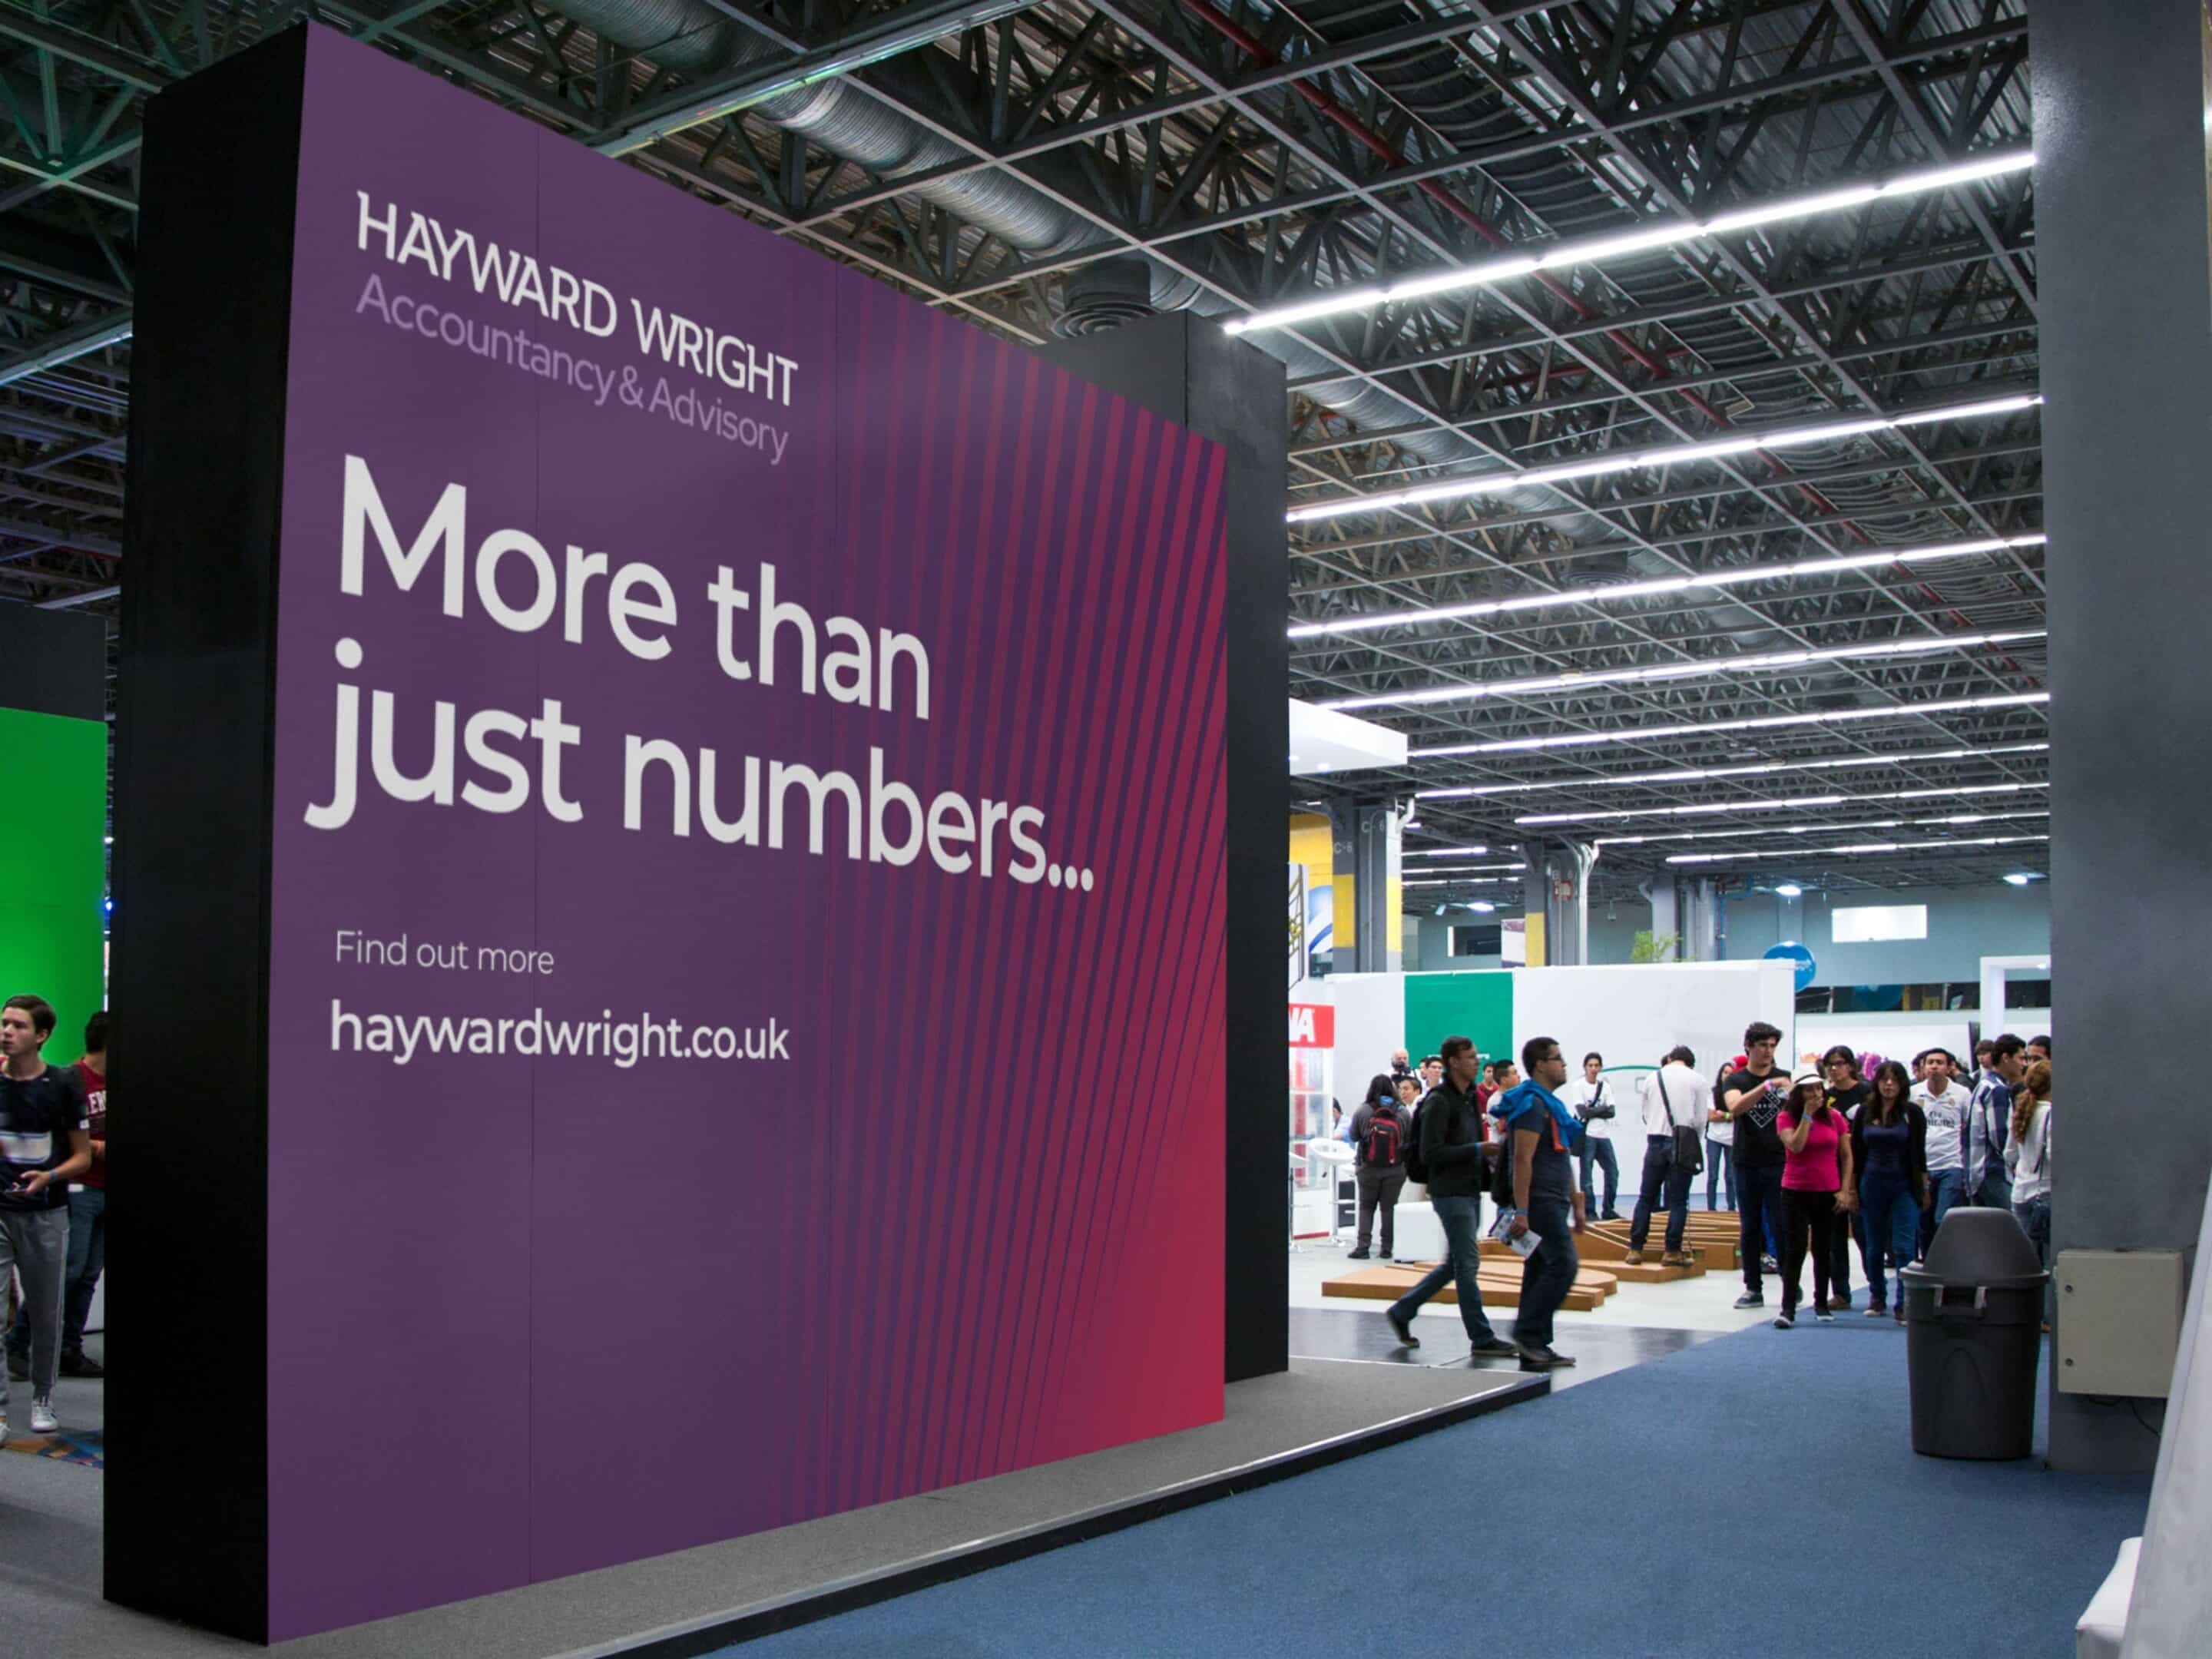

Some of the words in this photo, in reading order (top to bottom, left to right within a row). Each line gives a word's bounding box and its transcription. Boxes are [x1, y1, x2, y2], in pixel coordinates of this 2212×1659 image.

[356, 190, 618, 338] HAYWARD
[631, 297, 799, 407] WRIGHT
[341, 453, 678, 661] More
[707, 561, 929, 720] than
[303, 637, 584, 830] just
[624, 733, 1094, 892] numbers...
[330, 998, 790, 1068] haywardwright.co.uk
[336, 930, 407, 965] Find
[416, 942, 469, 970] out
[478, 948, 555, 975] more
